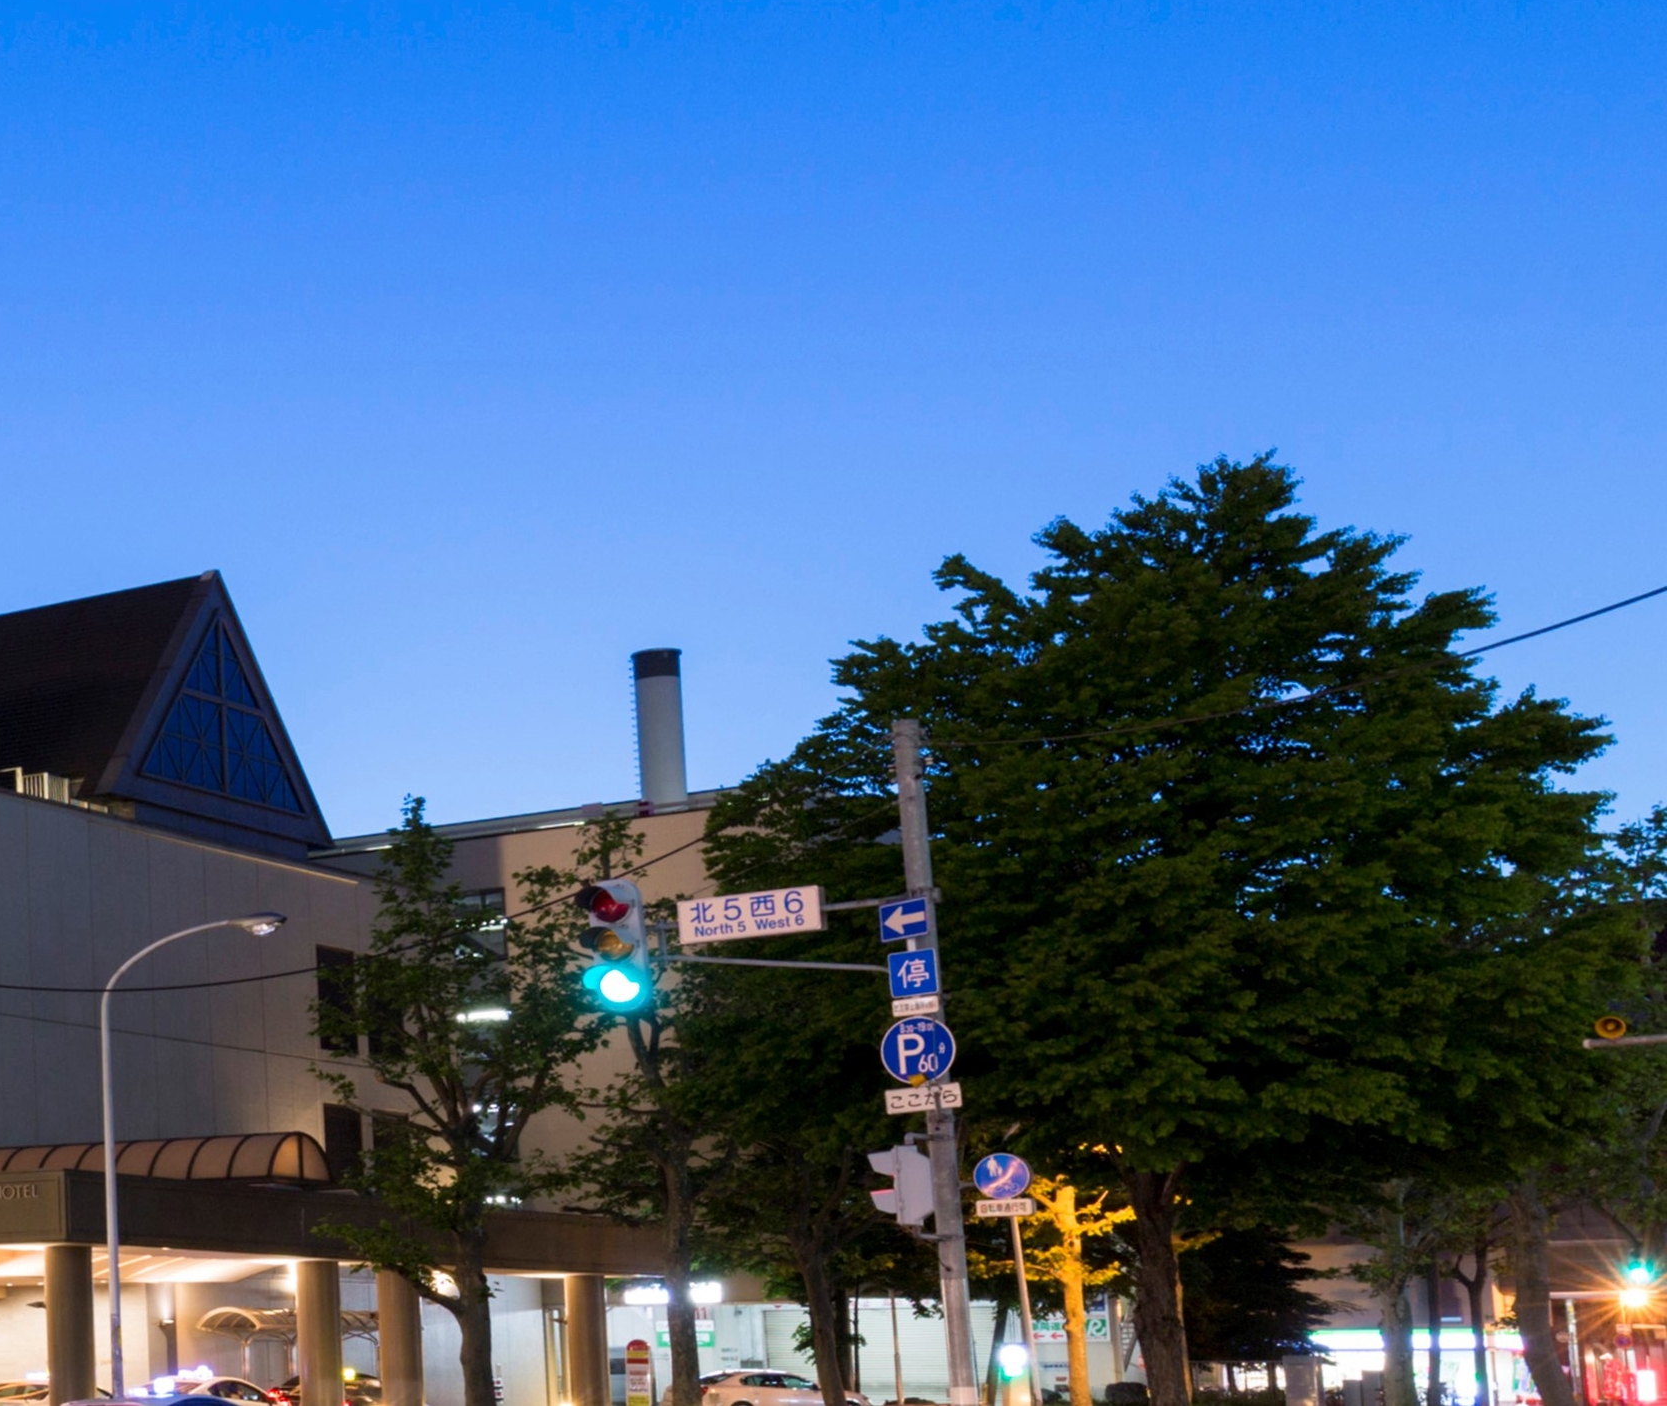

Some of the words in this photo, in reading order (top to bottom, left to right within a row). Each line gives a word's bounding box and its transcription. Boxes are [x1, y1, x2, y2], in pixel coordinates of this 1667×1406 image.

[689, 890, 805, 925] 北5西6
[694, 922, 734, 938] North
[737, 920, 747, 933] 5
[754, 916, 791, 931] West
[794, 914, 805, 926] 6
[897, 958, 930, 989] 停
[897, 1033, 925, 1074] P
